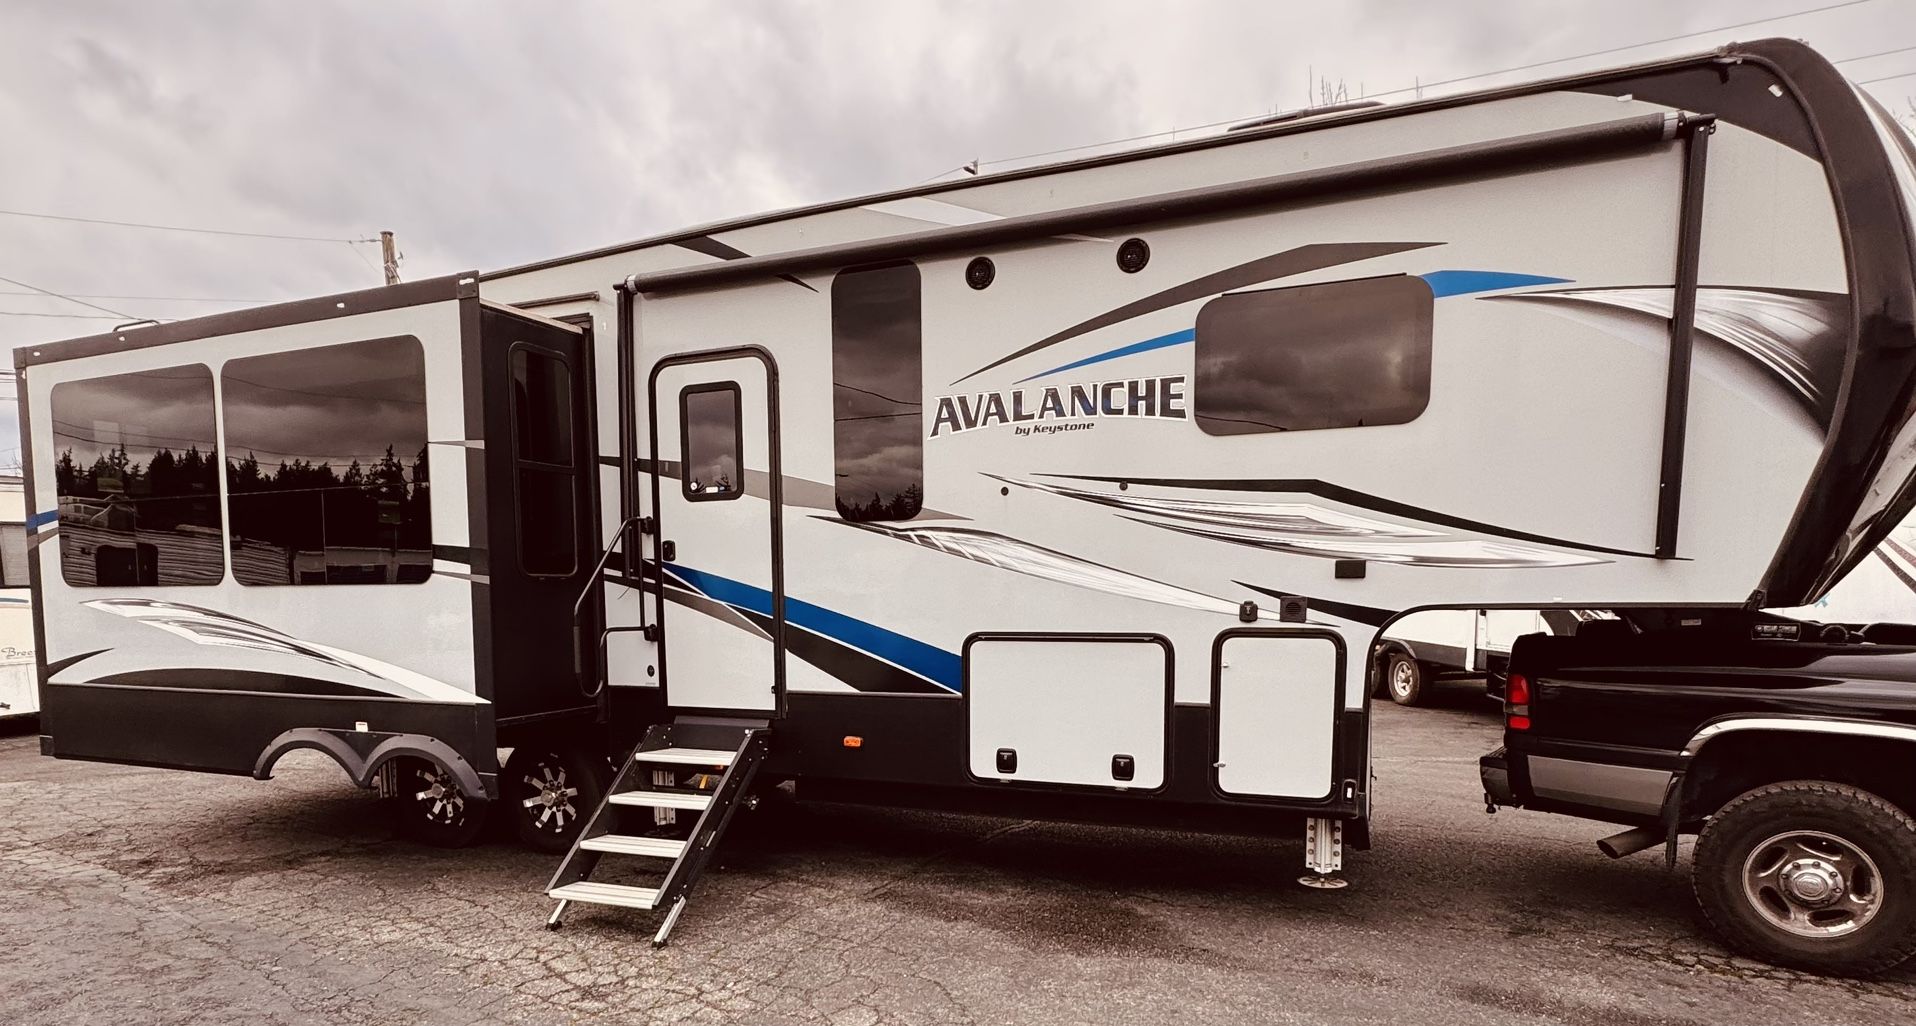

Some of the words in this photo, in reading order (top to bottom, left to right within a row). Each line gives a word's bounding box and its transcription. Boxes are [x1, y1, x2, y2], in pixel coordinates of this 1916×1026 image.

[928, 375, 1187, 440] AVALANCHE
[1015, 426, 1031, 436] by
[1033, 422, 1095, 435] Keystone
[1, 646, 35, 657] Bree
